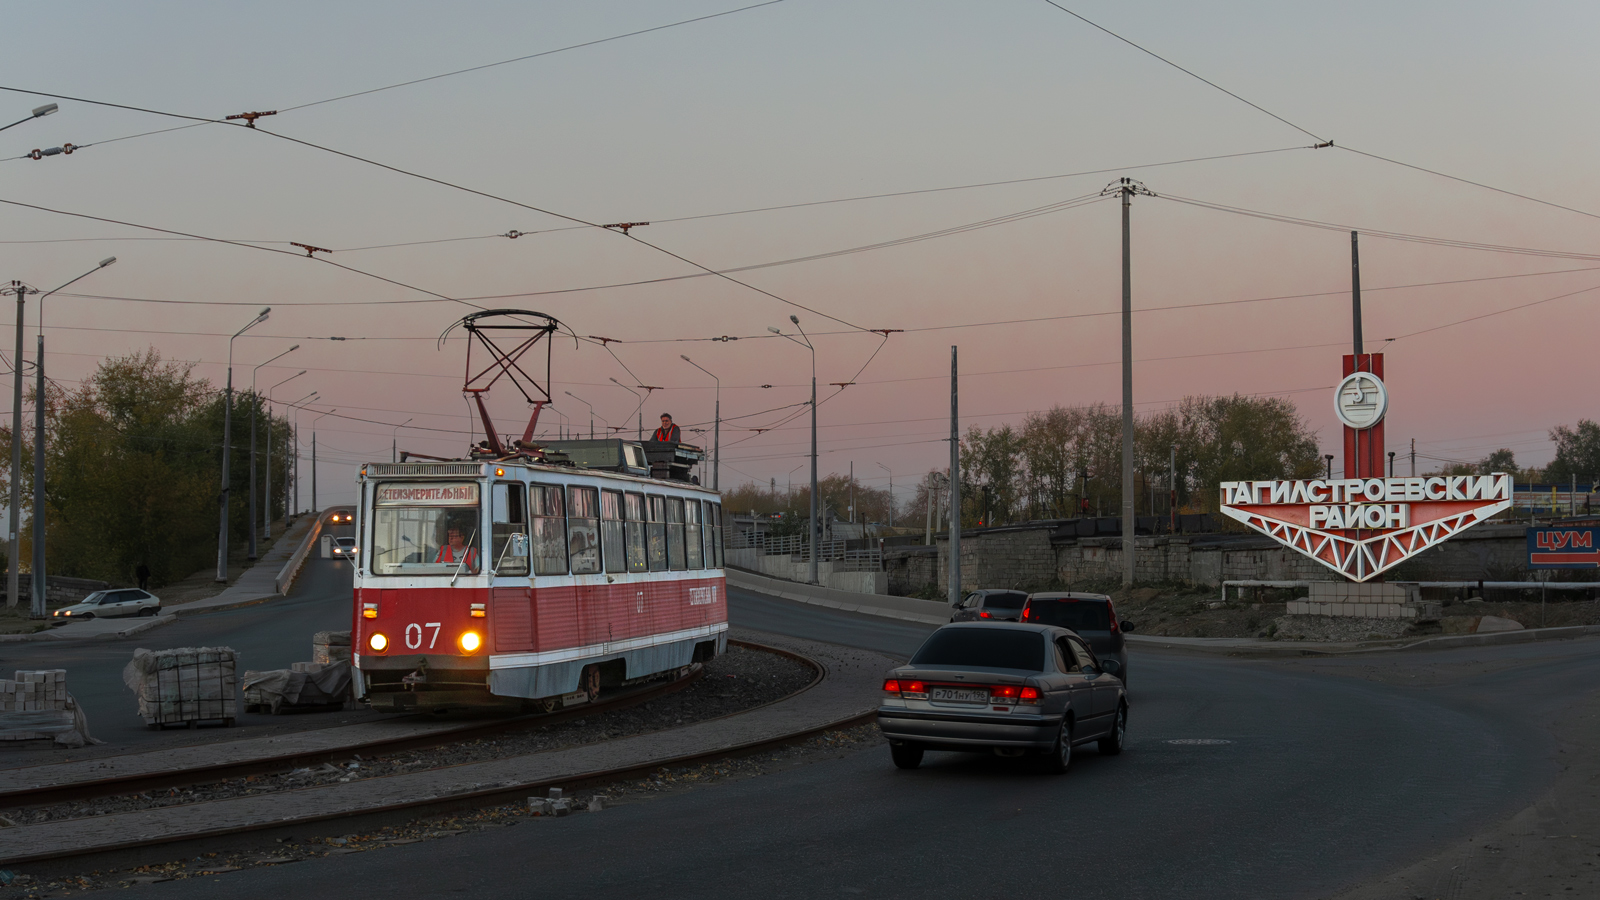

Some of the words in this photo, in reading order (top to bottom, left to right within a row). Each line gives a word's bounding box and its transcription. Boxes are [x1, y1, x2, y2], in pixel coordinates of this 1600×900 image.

[1221, 473, 1510, 504] ТАГИЛСТРОЕВСКИЙ
[1310, 502, 1406, 529] РАЙОН
[1536, 531, 1592, 551] ЦУМ
[405, 622, 441, 649] 07
